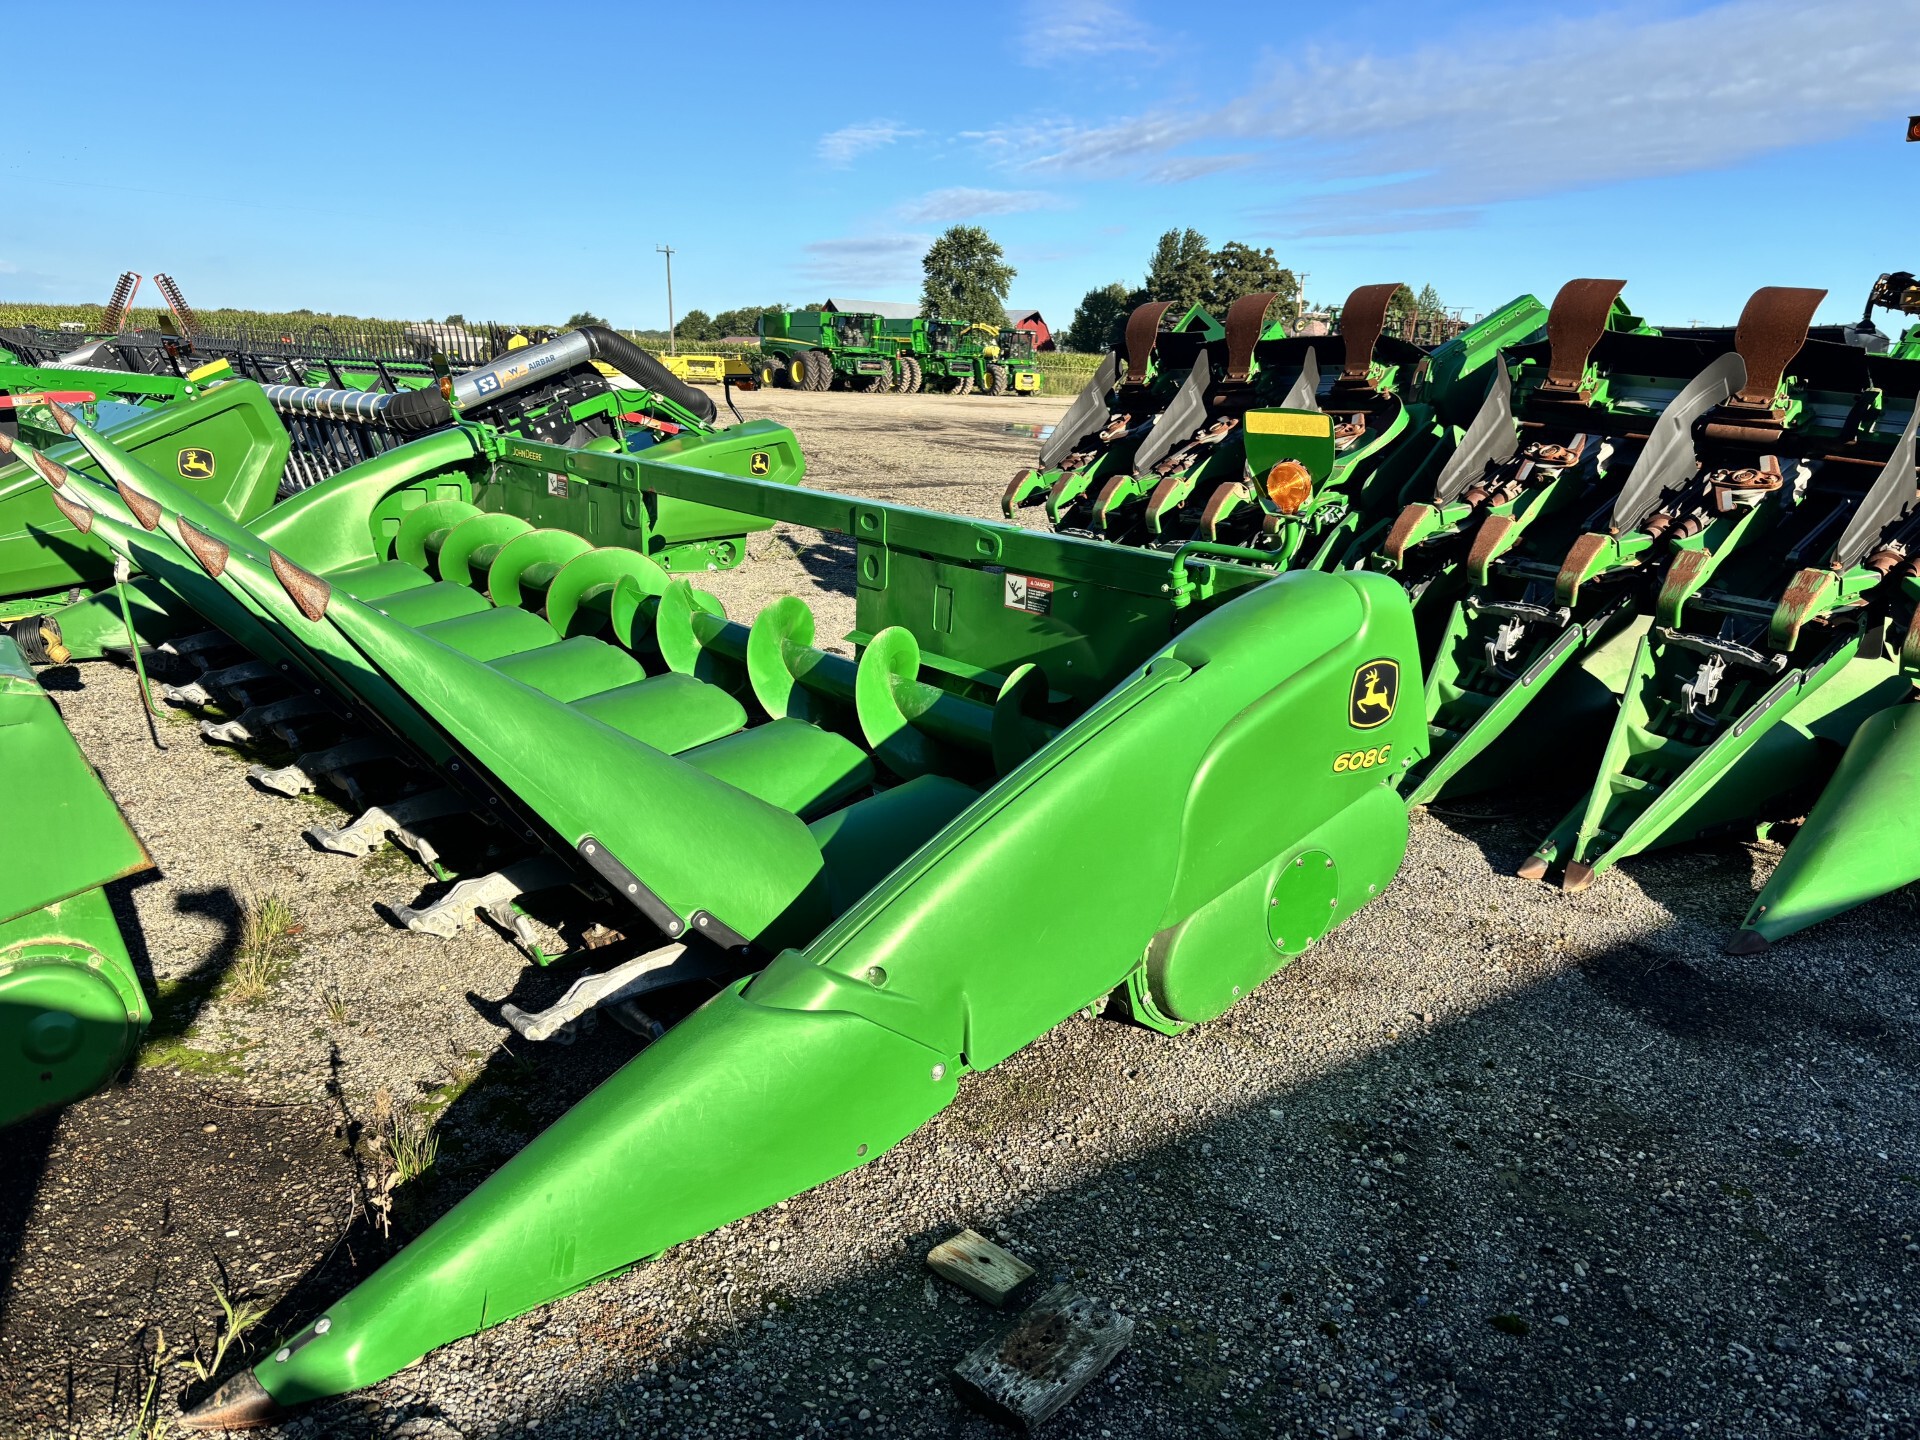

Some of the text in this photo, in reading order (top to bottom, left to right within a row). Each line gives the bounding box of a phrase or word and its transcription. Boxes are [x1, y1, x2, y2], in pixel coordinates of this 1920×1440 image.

[478, 376, 497, 393] S3
[528, 354, 556, 371] AIRBAR
[512, 446, 543, 462] JOHN DEERE
[1033, 580, 1051, 589] DANGER
[1333, 744, 1392, 773] 608C
